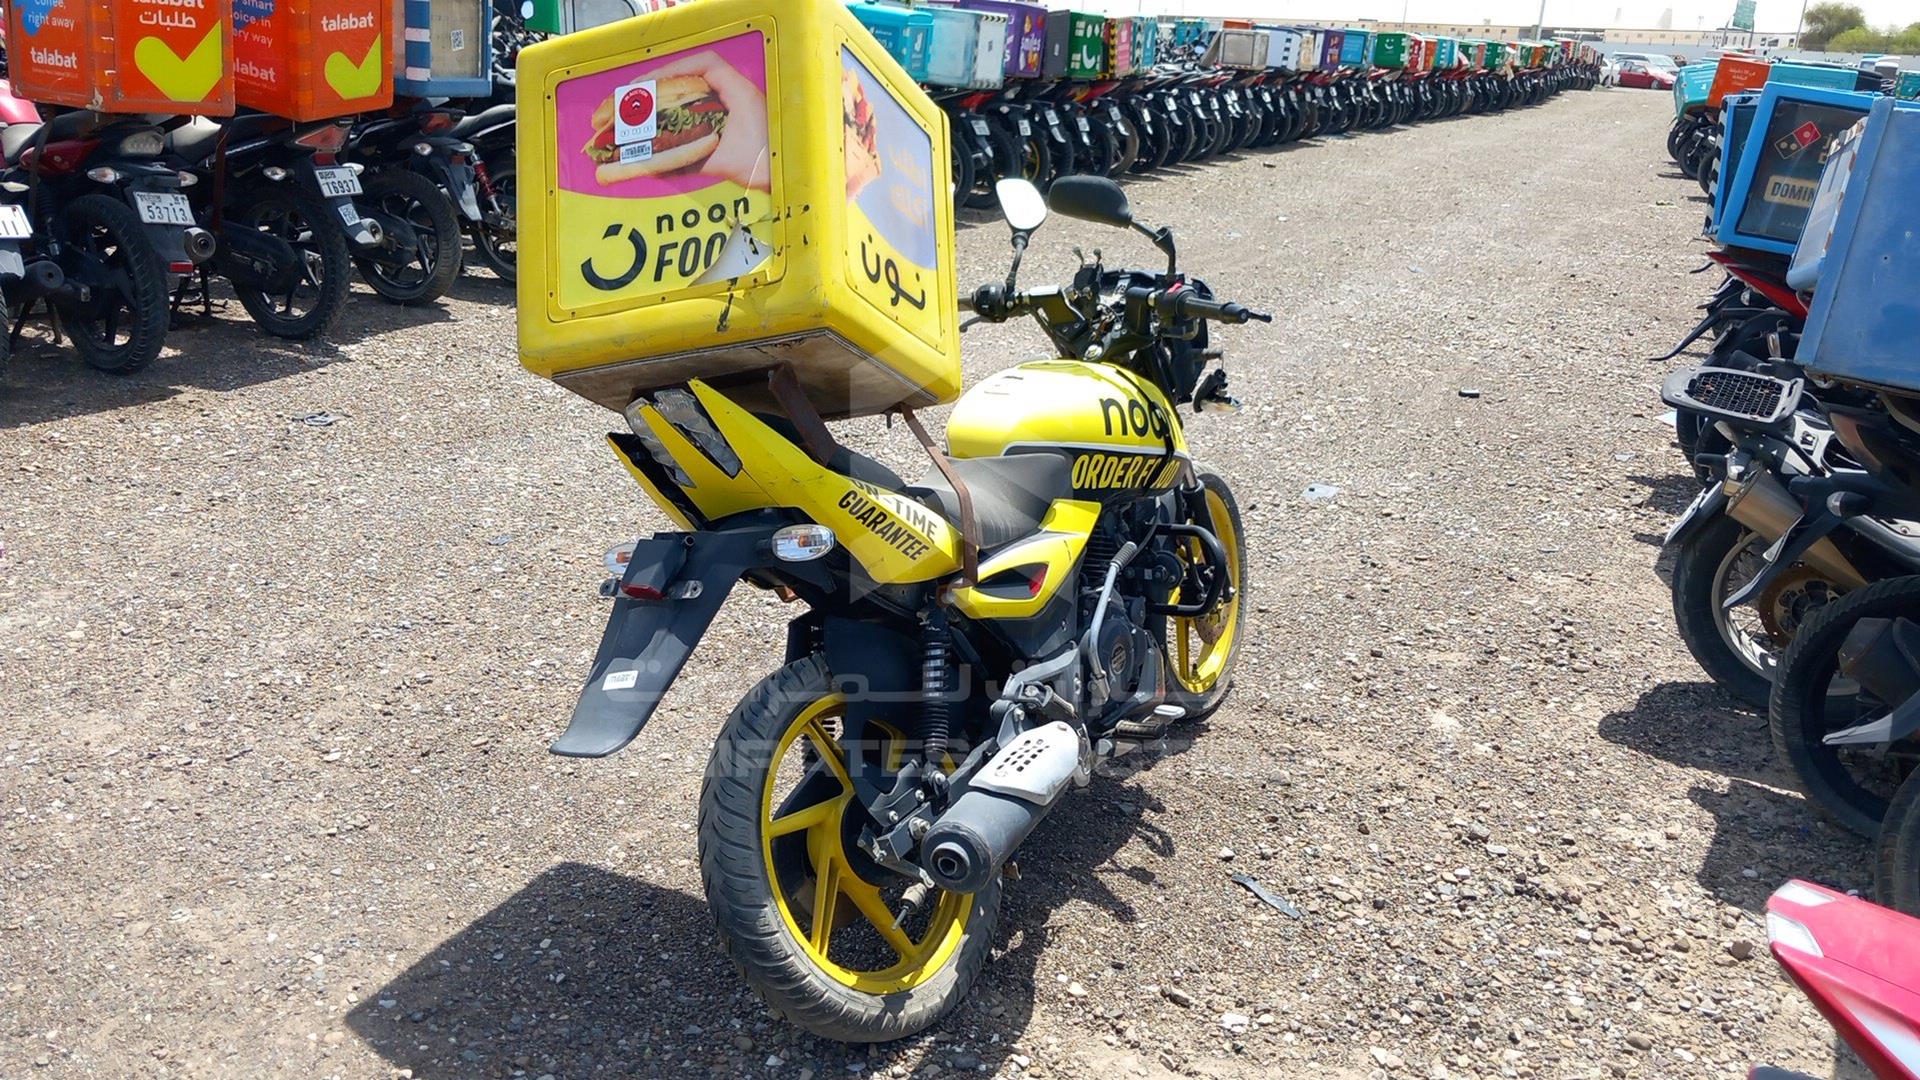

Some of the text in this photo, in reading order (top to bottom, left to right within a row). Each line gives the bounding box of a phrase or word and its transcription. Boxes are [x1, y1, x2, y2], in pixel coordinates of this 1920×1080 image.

[28, 11, 75, 31] right away
[139, 9, 196, 31] طلبات
[233, 11, 272, 28] oice, in
[321, 11, 374, 32] talabat
[232, 27, 273, 48] ery way
[31, 47, 78, 69] talabat
[233, 57, 276, 83] labat
[146, 205, 188, 223] 53713
[656, 197, 750, 234] noon
[653, 231, 728, 282] FOO
[861, 233, 926, 311] نون
[1071, 454, 1144, 490] ORDER
[838, 489, 930, 561] GUARANTEE
